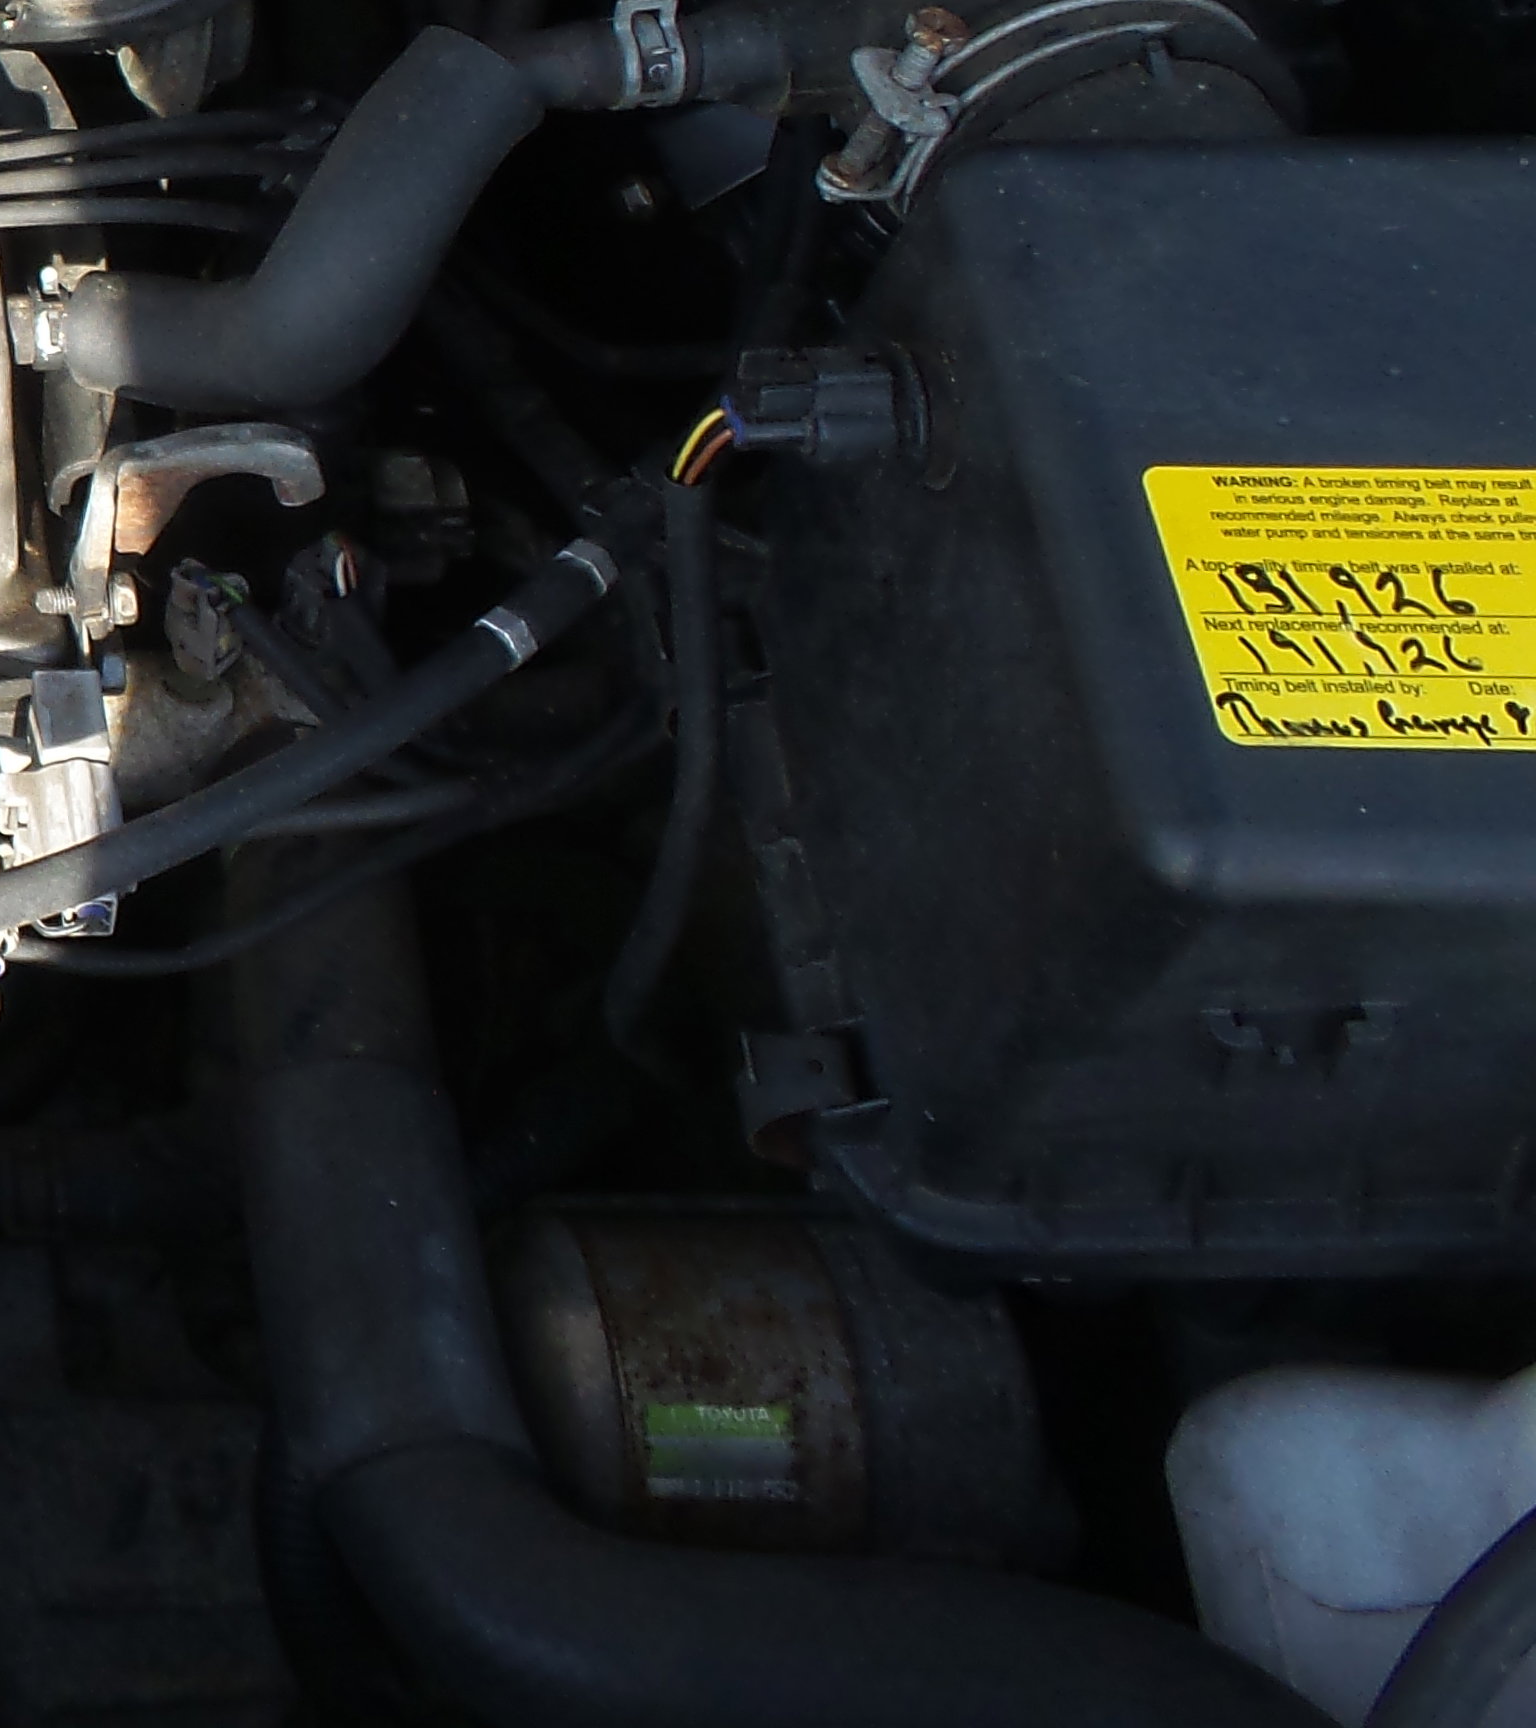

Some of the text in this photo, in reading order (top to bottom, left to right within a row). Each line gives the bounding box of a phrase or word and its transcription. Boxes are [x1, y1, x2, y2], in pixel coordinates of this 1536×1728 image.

[1212, 475, 1533, 493] WARNING: A broken timing belt may result
[1234, 492, 1247, 504] in
[1251, 493, 1305, 505] serious
[1309, 493, 1360, 508] engine
[1438, 493, 1500, 508] Replace
[1504, 495, 1520, 507] at
[1210, 509, 1316, 521] recommended
[1393, 511, 1446, 525] Always
[1450, 511, 1494, 523] check
[1498, 512, 1536, 526] pulle
[1220, 526, 1261, 538] water
[1264, 527, 1308, 541] pump
[1312, 527, 1341, 539] and
[1344, 528, 1424, 540] tensioners
[1428, 529, 1443, 540] at
[1446, 528, 1470, 540] the
[1474, 530, 1516, 541] same
[1186, 558, 1198, 571] A
[1201, 558, 1287, 574] top-ality
[1348, 560, 1380, 573] belt
[1386, 563, 1420, 574] was
[1424, 561, 1495, 575] installed
[1203, 617, 1245, 632] Next
[1248, 617, 1355, 635] replacemen
[1359, 620, 1483, 635] recommended
[1222, 677, 1281, 695] Timing
[1283, 679, 1318, 693] belt
[1321, 679, 1396, 694] installed
[1468, 681, 1517, 696] Date:
[694, 1404, 771, 1424] TOYOTA
